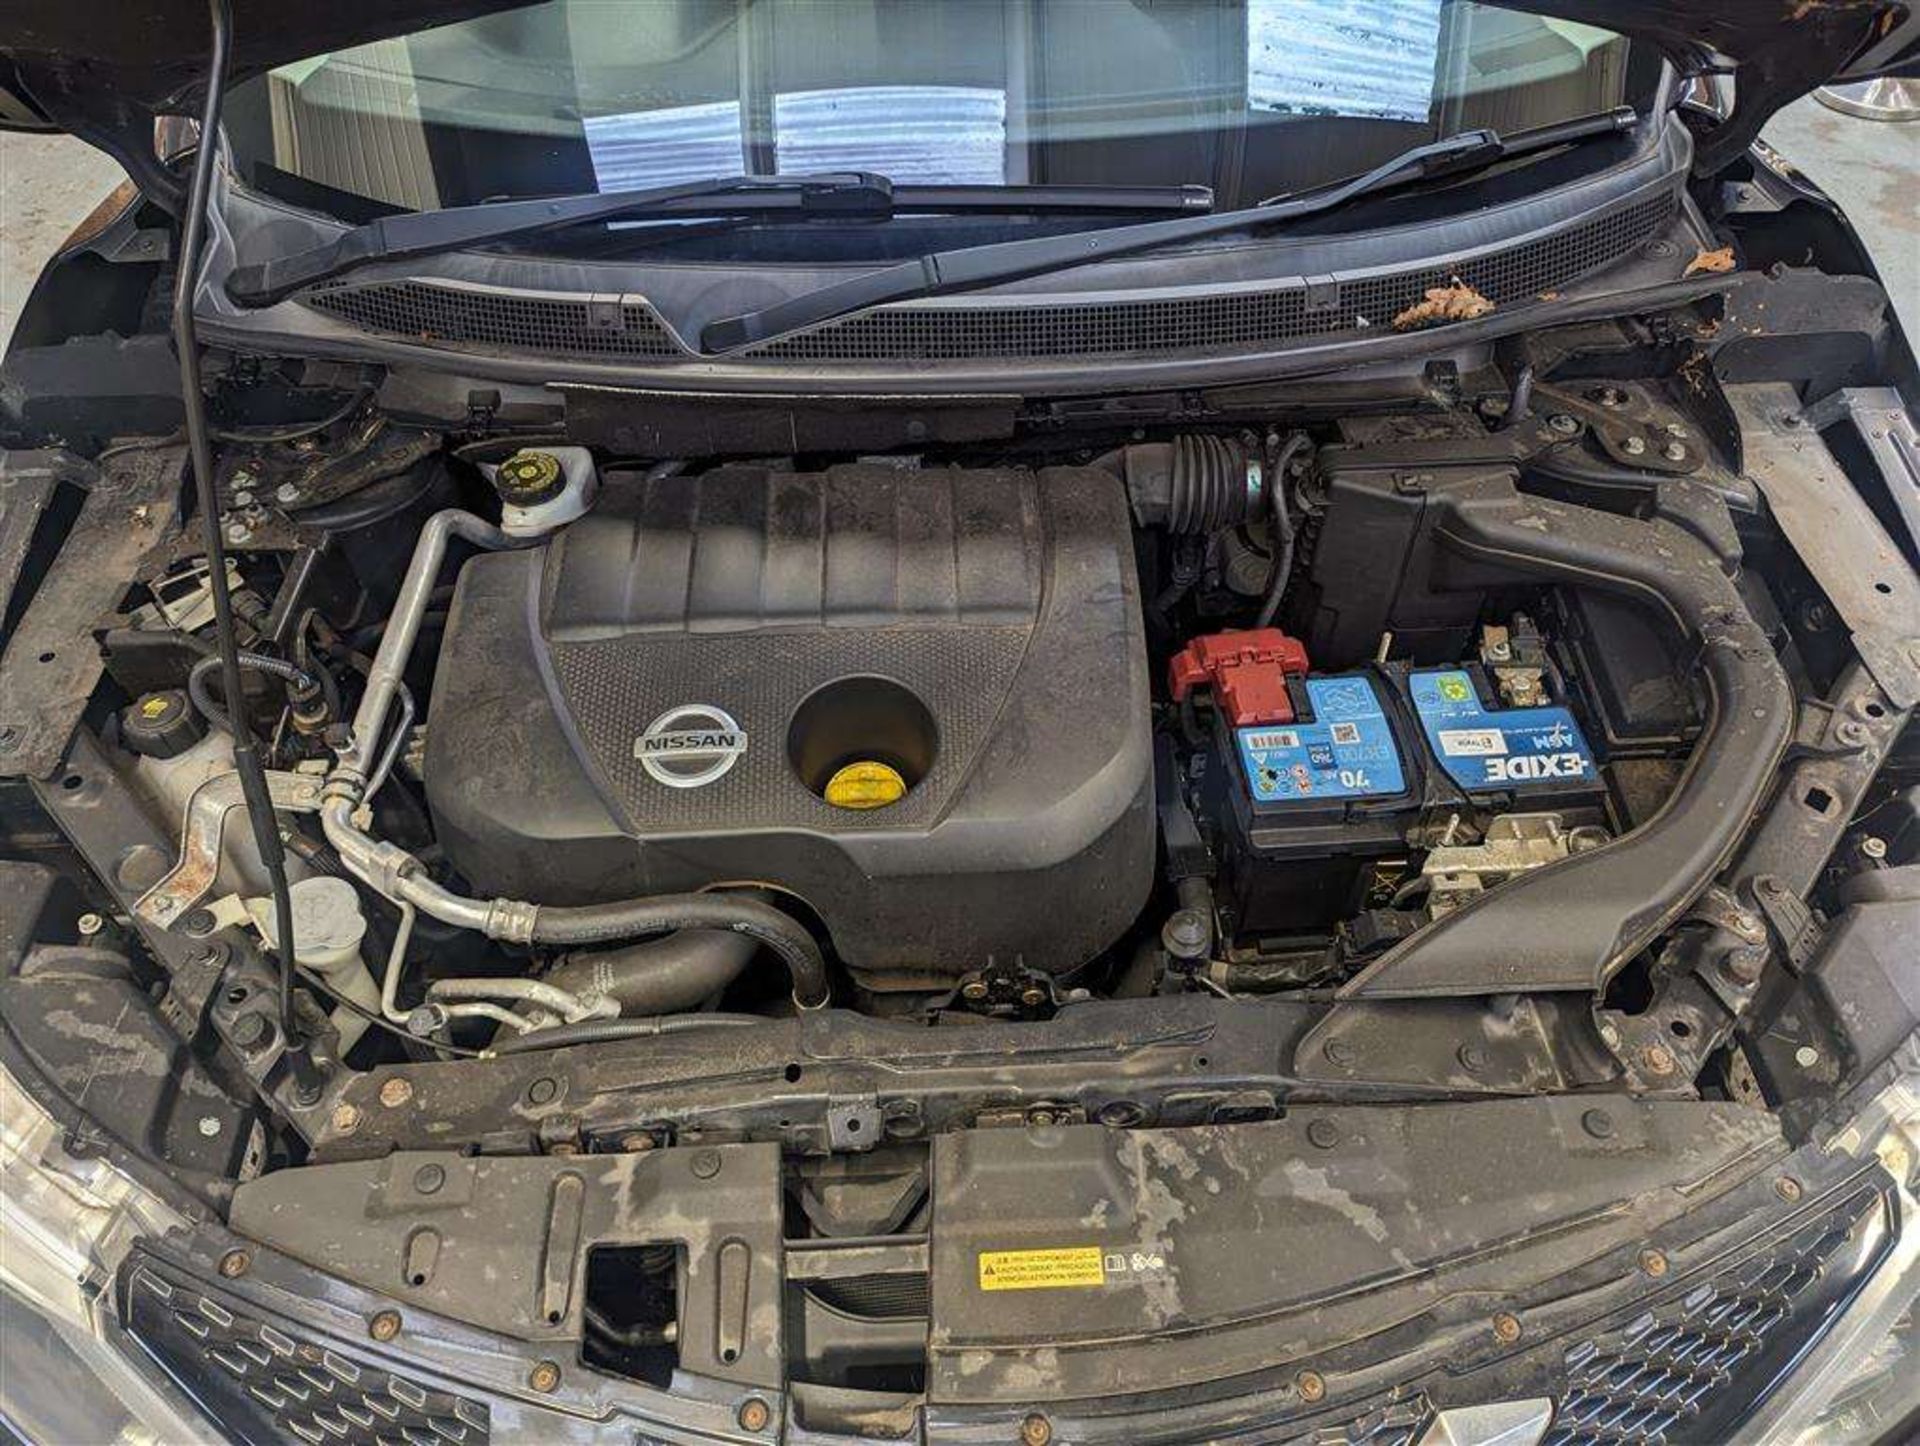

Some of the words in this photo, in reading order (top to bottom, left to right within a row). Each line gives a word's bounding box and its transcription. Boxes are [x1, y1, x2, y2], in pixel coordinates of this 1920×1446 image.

[645, 735, 735, 751] NISSAN
[1485, 753, 1588, 782] EXIDE
[1339, 770, 1370, 788] 70
